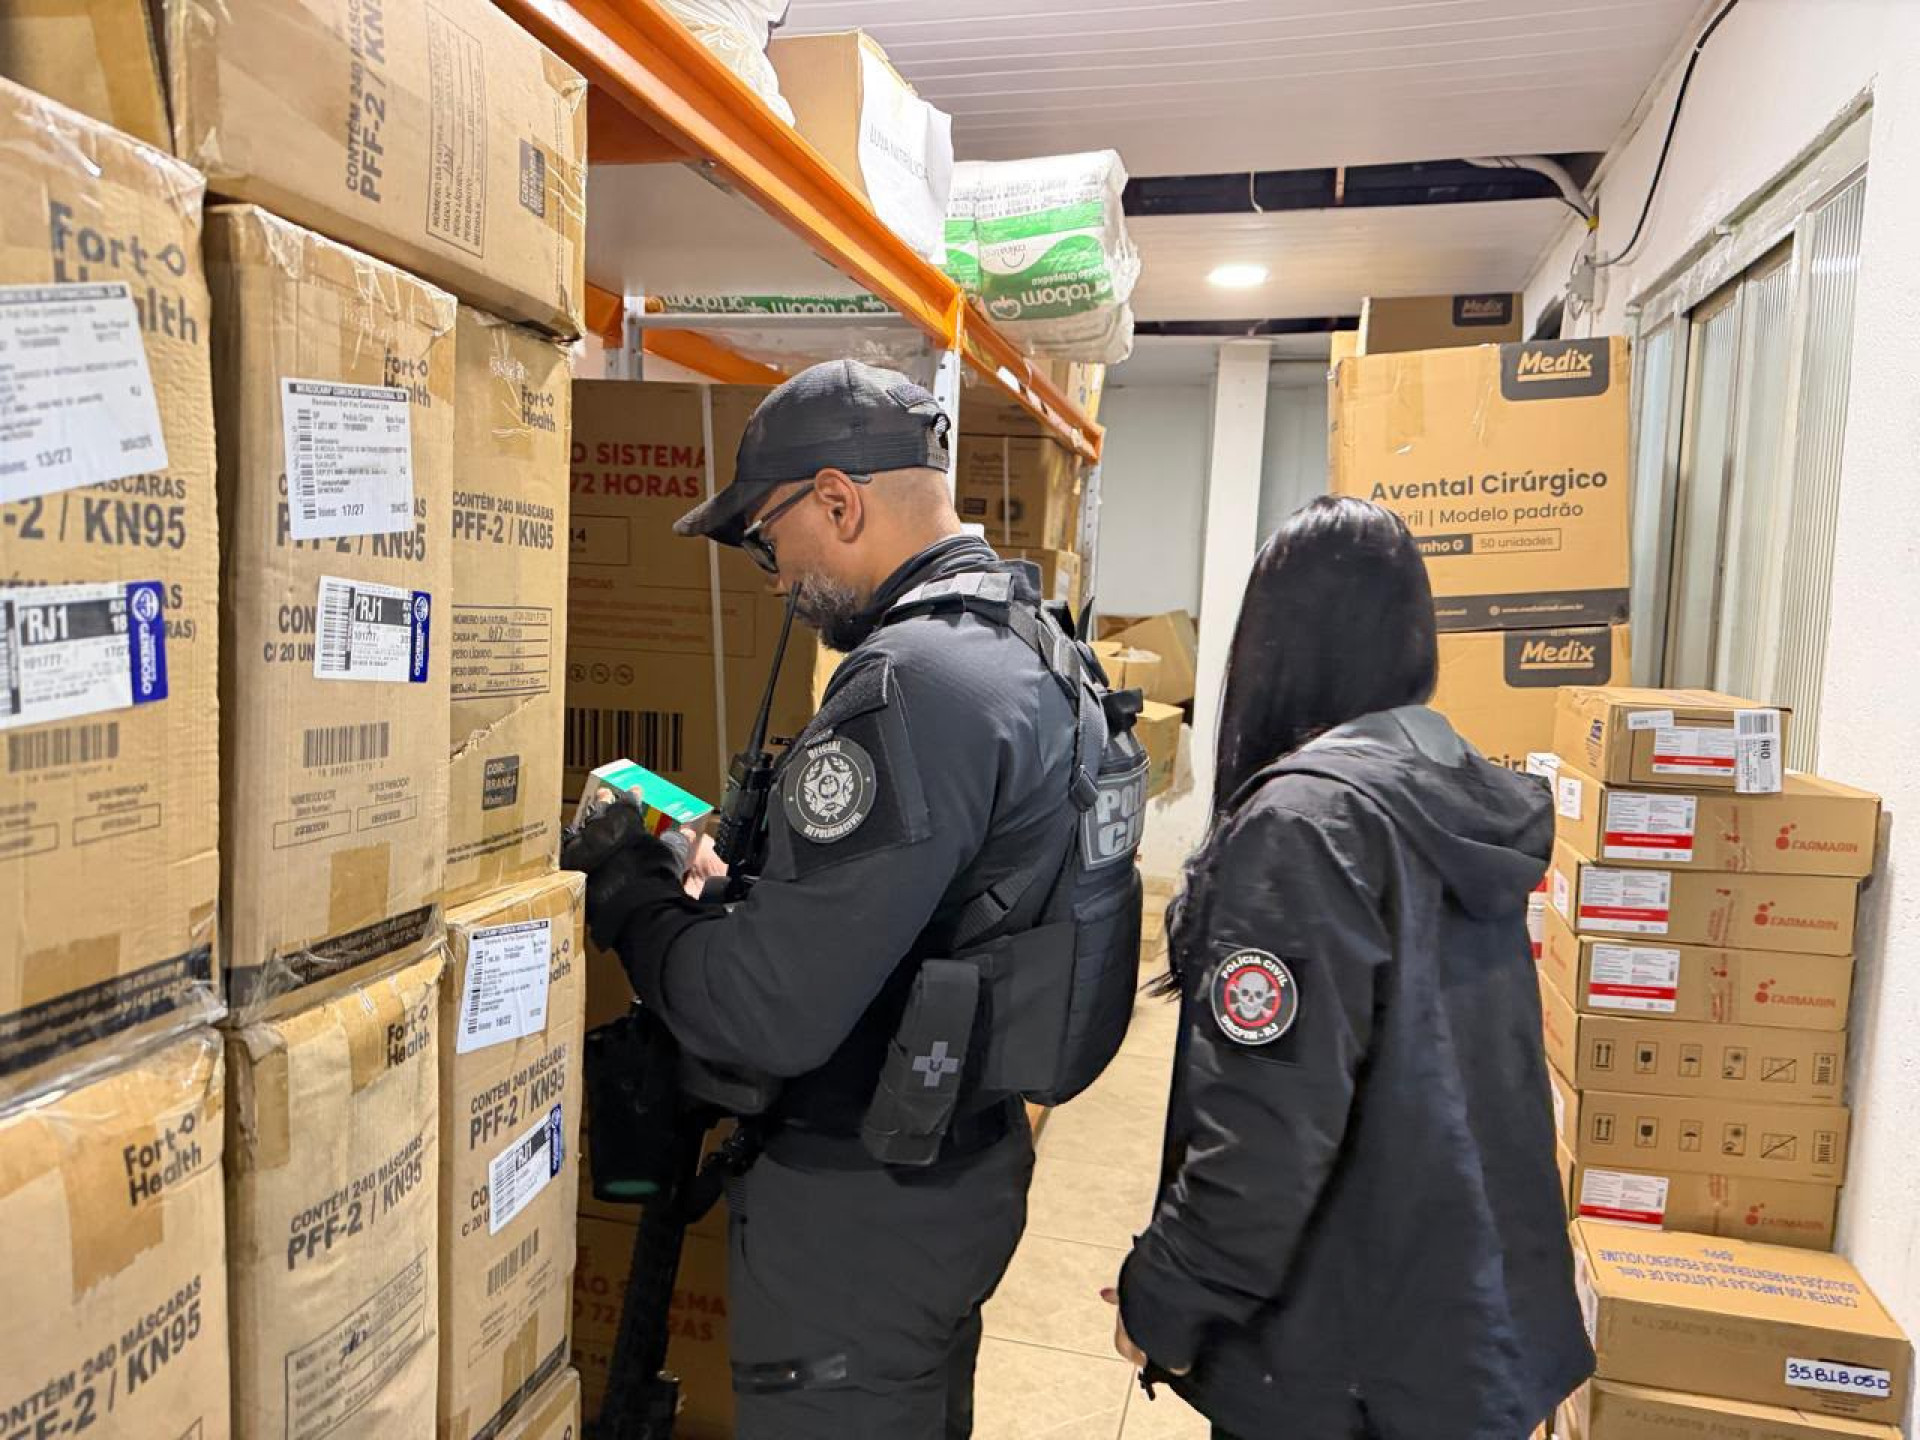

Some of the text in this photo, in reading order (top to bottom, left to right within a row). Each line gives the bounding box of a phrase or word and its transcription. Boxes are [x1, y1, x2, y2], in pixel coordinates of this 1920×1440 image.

[360, 93, 386, 203] PFF-2
[49, 200, 149, 276] Fort
[384, 347, 416, 377] Fort
[1517, 347, 1593, 374] Medix
[521, 384, 545, 408] Fort
[521, 404, 556, 433] Health
[603, 473, 700, 498] HORAS
[1370, 468, 1608, 502] Avental Cirúrgico
[452, 491, 496, 511] CONTÉM
[497, 497, 514, 514] 240
[1438, 505, 1508, 525] Modelo
[1513, 502, 1584, 525] padrão
[84, 497, 187, 549] KN95
[452, 509, 505, 544] PFF-2
[518, 518, 554, 550] KN95
[1453, 539, 1464, 551] G
[1479, 537, 1495, 550] 50
[1497, 535, 1555, 549] unidades
[280, 643, 295, 662] 20
[1520, 639, 1596, 663] Medix
[1760, 740, 1771, 760] RIO
[1263, 959, 1288, 988] CIVIL
[387, 1012, 418, 1045] Fort
[386, 1025, 430, 1069] Health
[513, 1068, 528, 1091] 240
[470, 1094, 518, 1150] PFF-2
[531, 1063, 565, 1113] KN95
[123, 1127, 177, 1177] Fort
[129, 1140, 202, 1207] Health
[287, 1201, 364, 1272] PFF-2
[383, 1150, 424, 1215] KN95
[290, 1184, 349, 1234] CONTÉM
[352, 1172, 376, 1199] 240
[82, 1342, 117, 1384] 240
[127, 1299, 201, 1396] KN95
